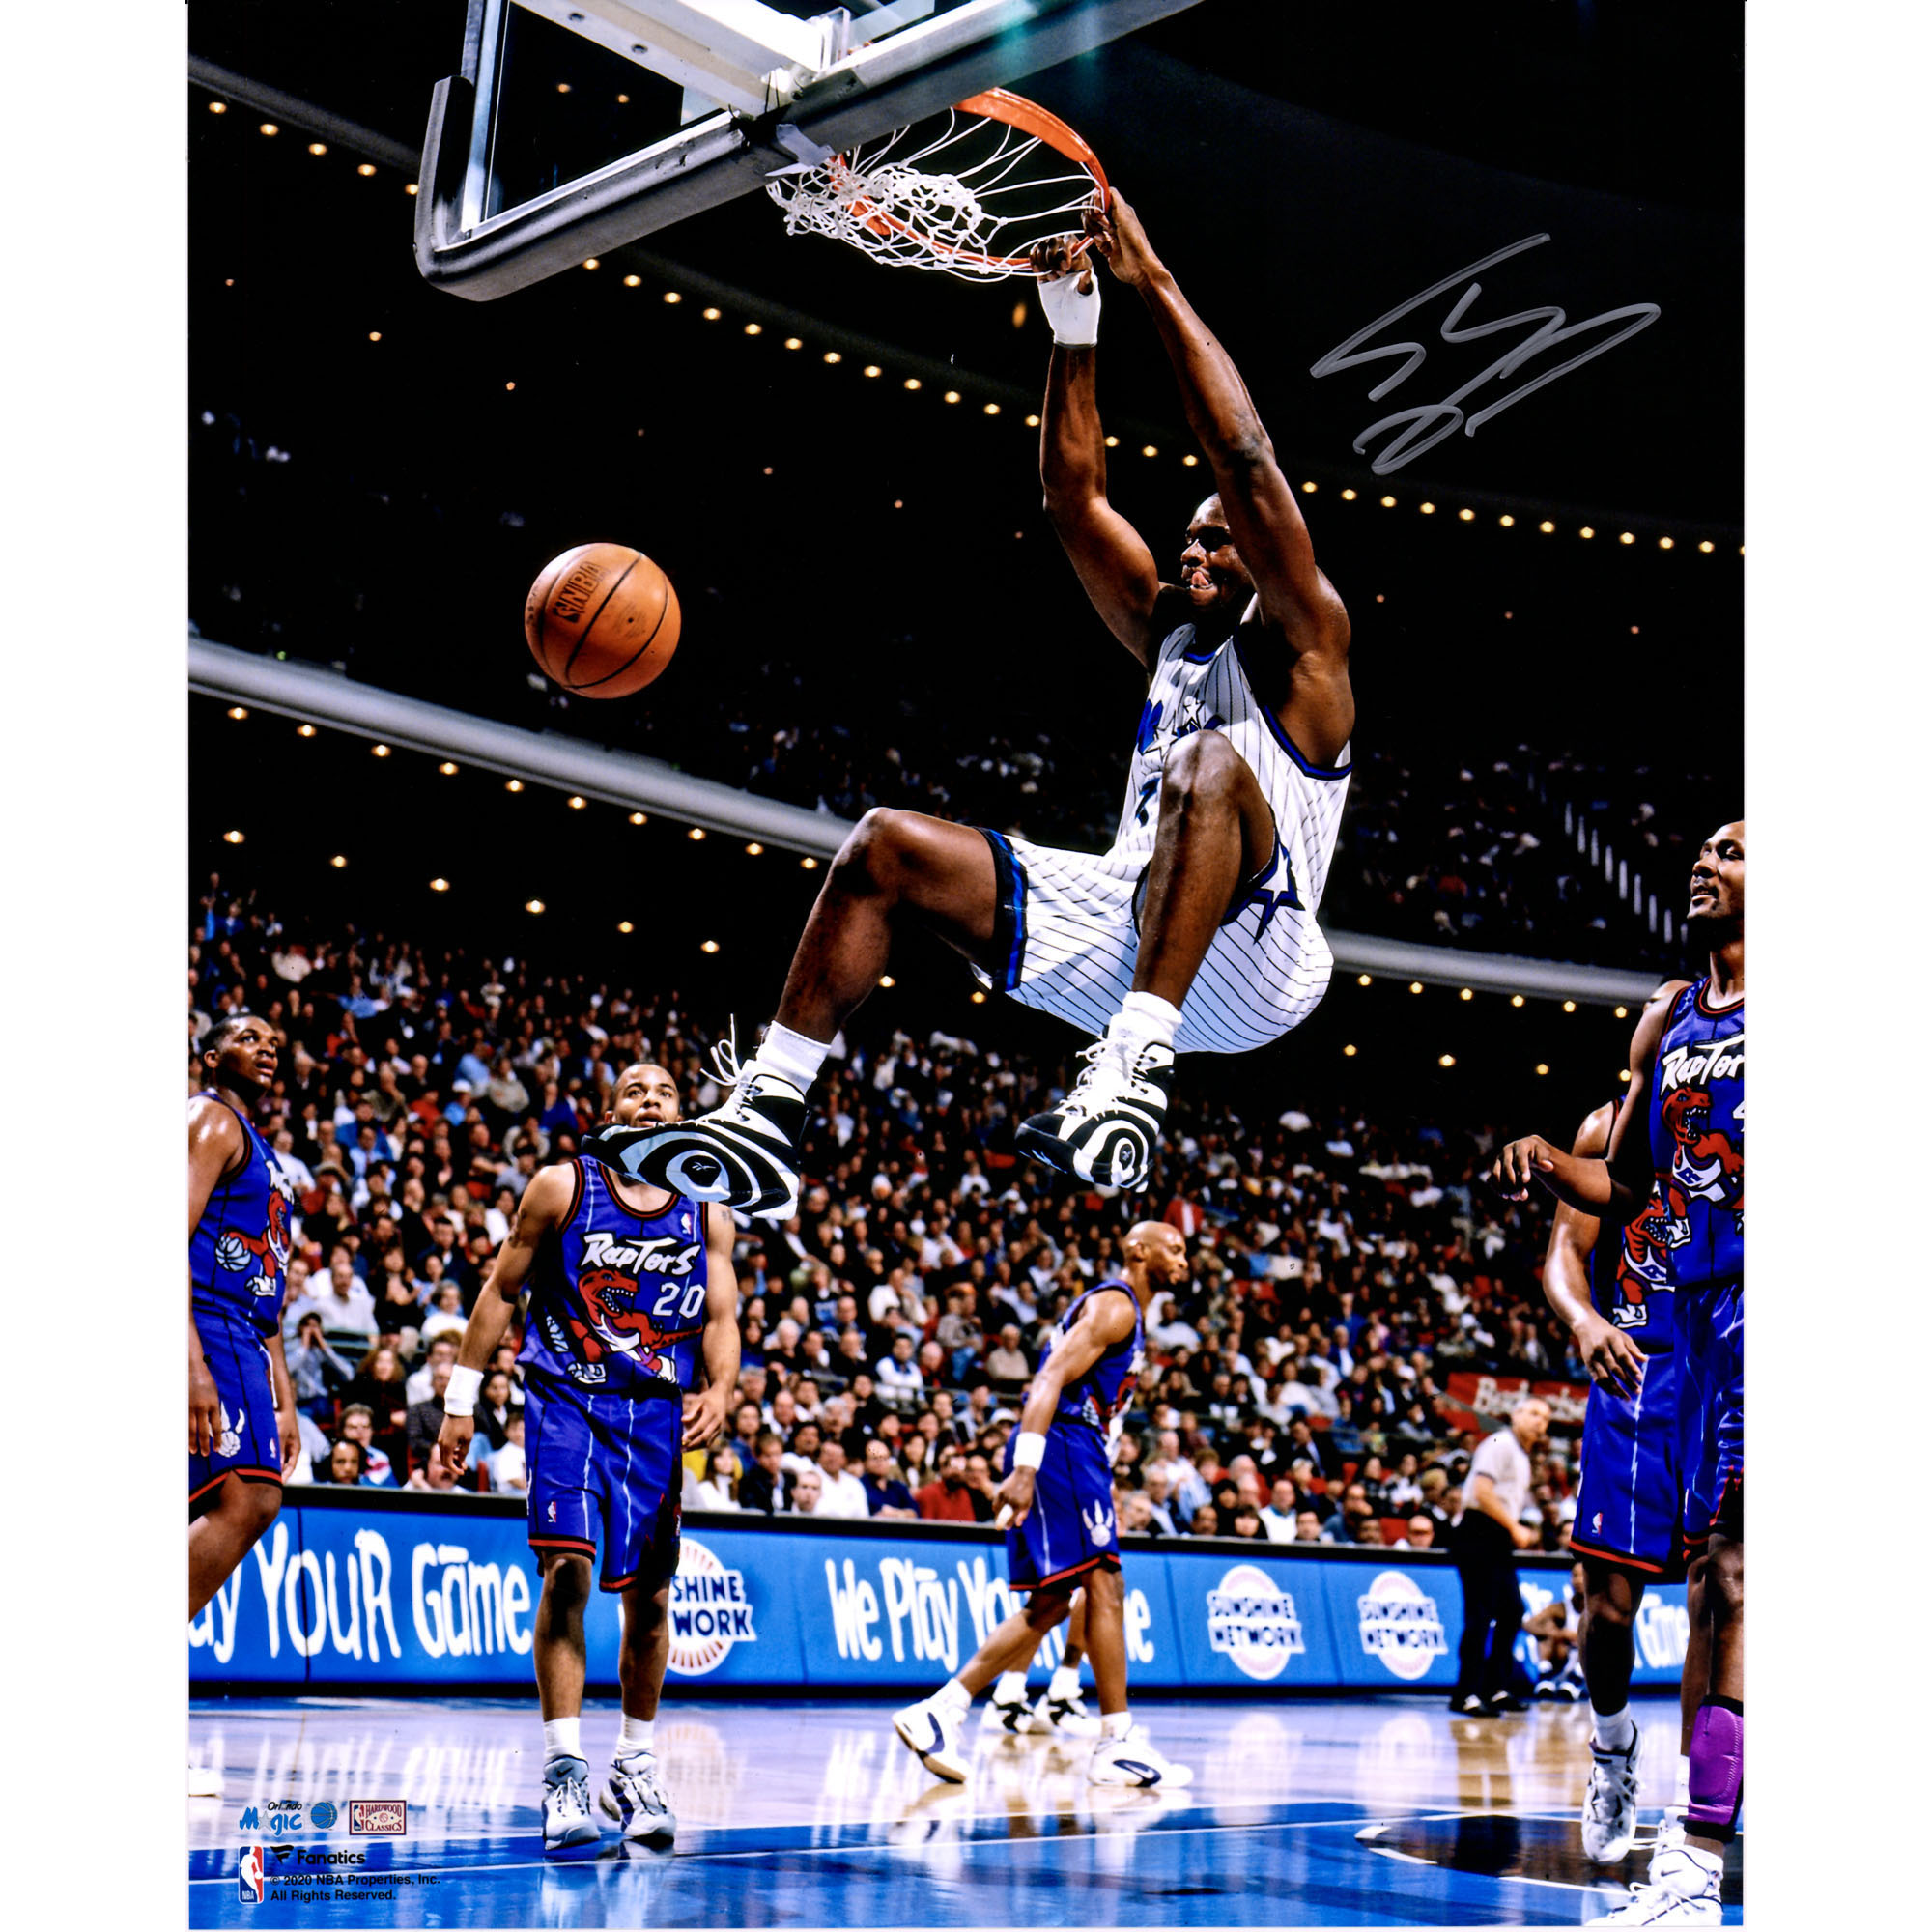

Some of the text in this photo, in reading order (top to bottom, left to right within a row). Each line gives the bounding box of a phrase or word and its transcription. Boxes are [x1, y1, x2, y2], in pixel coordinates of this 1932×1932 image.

[556, 560, 611, 613] NBA
[652, 1282, 706, 1319] 20
[824, 1557, 883, 1662] We
